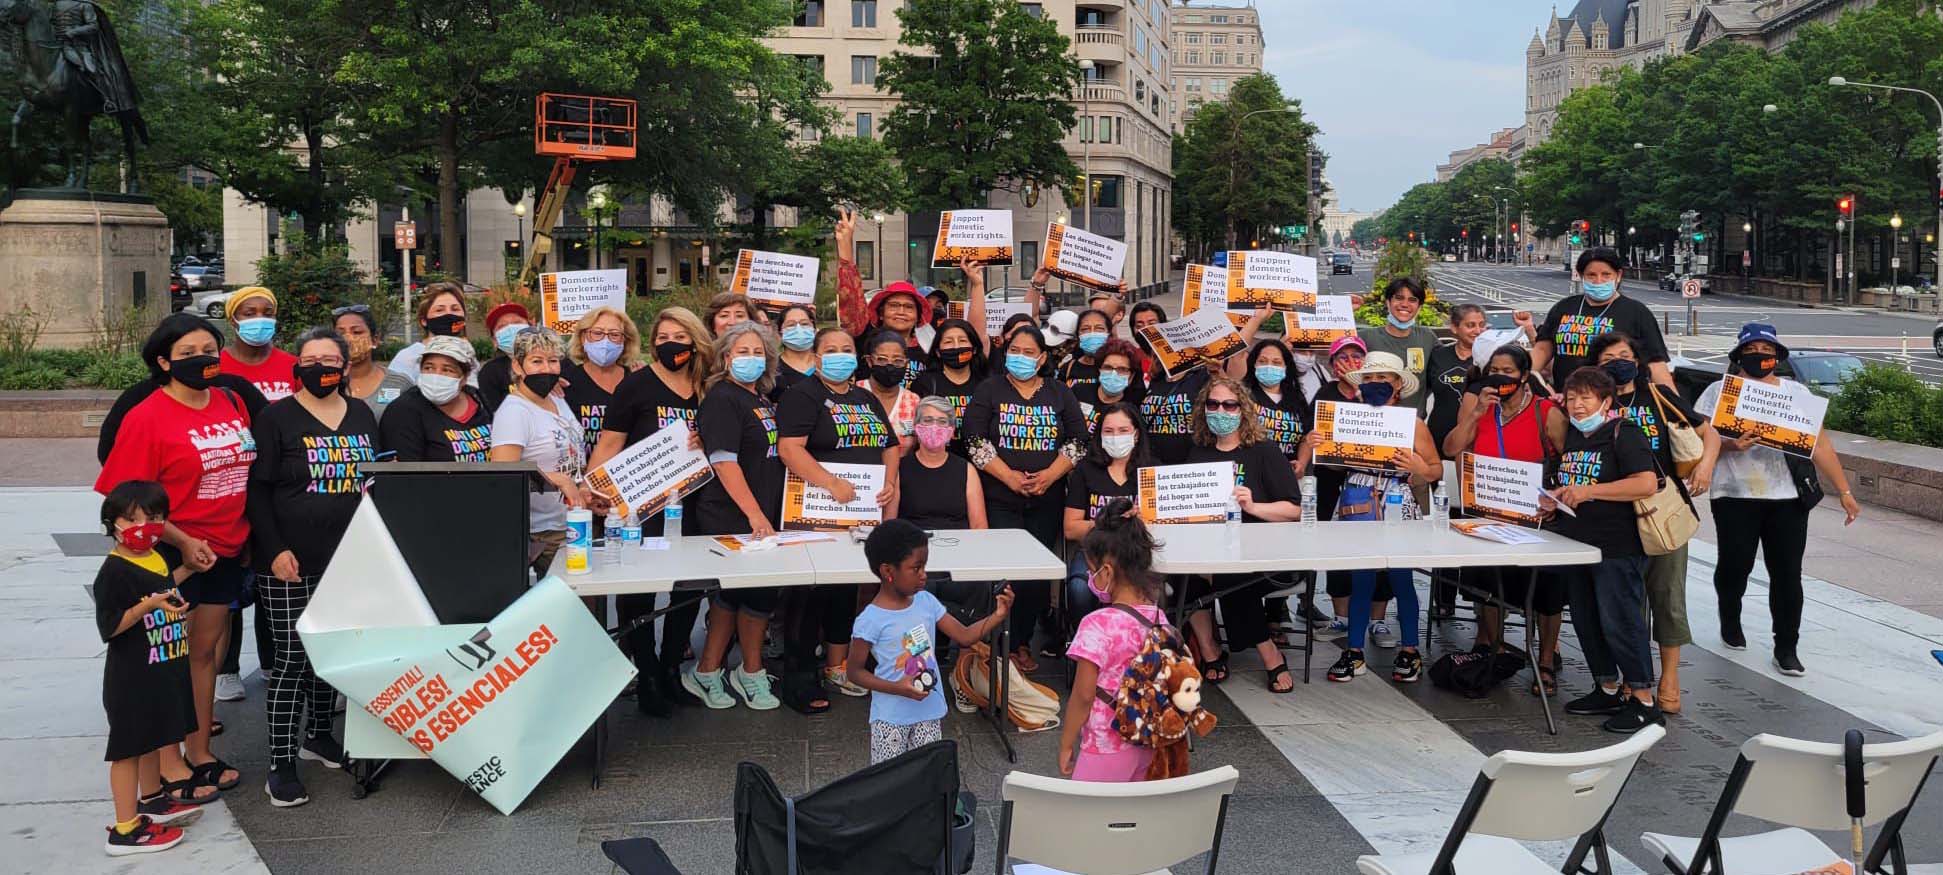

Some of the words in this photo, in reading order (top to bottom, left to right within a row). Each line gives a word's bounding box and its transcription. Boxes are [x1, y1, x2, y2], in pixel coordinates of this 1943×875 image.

[977, 232, 1007, 240] rights.
[1065, 232, 1076, 240] Los
[1078, 236, 1105, 249] derechos
[1062, 249, 1072, 257] del
[1073, 252, 1092, 263] hogar
[1074, 244, 1112, 261] trabajadores
[765, 259, 794, 268] derechos
[1061, 259, 1089, 270] derechos
[1255, 257, 1291, 265] support
[1250, 265, 1291, 273] domestic
[561, 276, 604, 285] Domestic
[1283, 275, 1312, 285] rights.
[561, 285, 593, 294] worker
[596, 284, 619, 293] rights
[578, 294, 608, 302] human
[1165, 319, 1196, 332] support
[1561, 314, 1614, 327] NATIONAL
[1167, 326, 1200, 338] domestic
[1172, 336, 1197, 344] worker
[1198, 323, 1226, 341] rights.
[1557, 323, 1613, 334] DOMESTIC
[1556, 333, 1593, 344] WORKE
[1752, 386, 1793, 402] support
[1744, 394, 1792, 410] domestic
[656, 406, 697, 419] NATIO
[1000, 403, 1056, 415] NATIONAL
[1345, 409, 1384, 419] support
[1742, 403, 1778, 416] worker
[1779, 412, 1814, 426] rights.
[1000, 413, 1057, 426] DOMESTIC
[1258, 416, 1303, 432] OMESTIC
[1339, 417, 1384, 427] domestic
[444, 424, 493, 441] NATION
[836, 423, 888, 436] WORKERS
[999, 424, 1058, 438] WORKERS
[1267, 429, 1302, 443] RKERS
[1338, 428, 1372, 436] worker
[1374, 430, 1407, 439] rights.
[303, 434, 371, 448] NATIONAL
[836, 435, 888, 449] ALLIANCE
[999, 436, 1056, 451] ALLIANCE
[307, 448, 375, 463] DOMESTIC
[455, 452, 492, 464] WORK
[609, 463, 625, 475] Los
[625, 441, 662, 465] derechos
[662, 435, 672, 444] de
[308, 463, 364, 478] WORKE
[615, 474, 628, 485] los
[629, 444, 679, 476] trabajadores
[1475, 461, 1486, 470] Los
[1488, 464, 1518, 474] derechos
[1520, 468, 1528, 476] de
[622, 482, 635, 494] del
[635, 468, 659, 485] hogar
[660, 459, 675, 470] son
[834, 472, 861, 480] rechos
[862, 472, 871, 480] de
[1171, 471, 1205, 480] derechos
[1486, 474, 1528, 486] trabajadores
[1558, 471, 1598, 487] ORKERS
[306, 479, 361, 493] ALLIAN
[628, 480, 663, 503] derechos
[1170, 481, 1219, 490] trabajadores
[1476, 482, 1486, 490] del
[1487, 484, 1507, 493] hogar
[806, 492, 819, 500] del
[1171, 493, 1193, 501] hogar
[1477, 492, 1505, 503] derechos
[805, 503, 843, 512] derechos
[1158, 503, 1193, 512] derechos
[147, 621, 188, 646] WORK
[149, 640, 189, 664] ALLIA
[371, 665, 425, 715] ESSENTIAL!
[426, 624, 559, 743] ESENCIALES!
